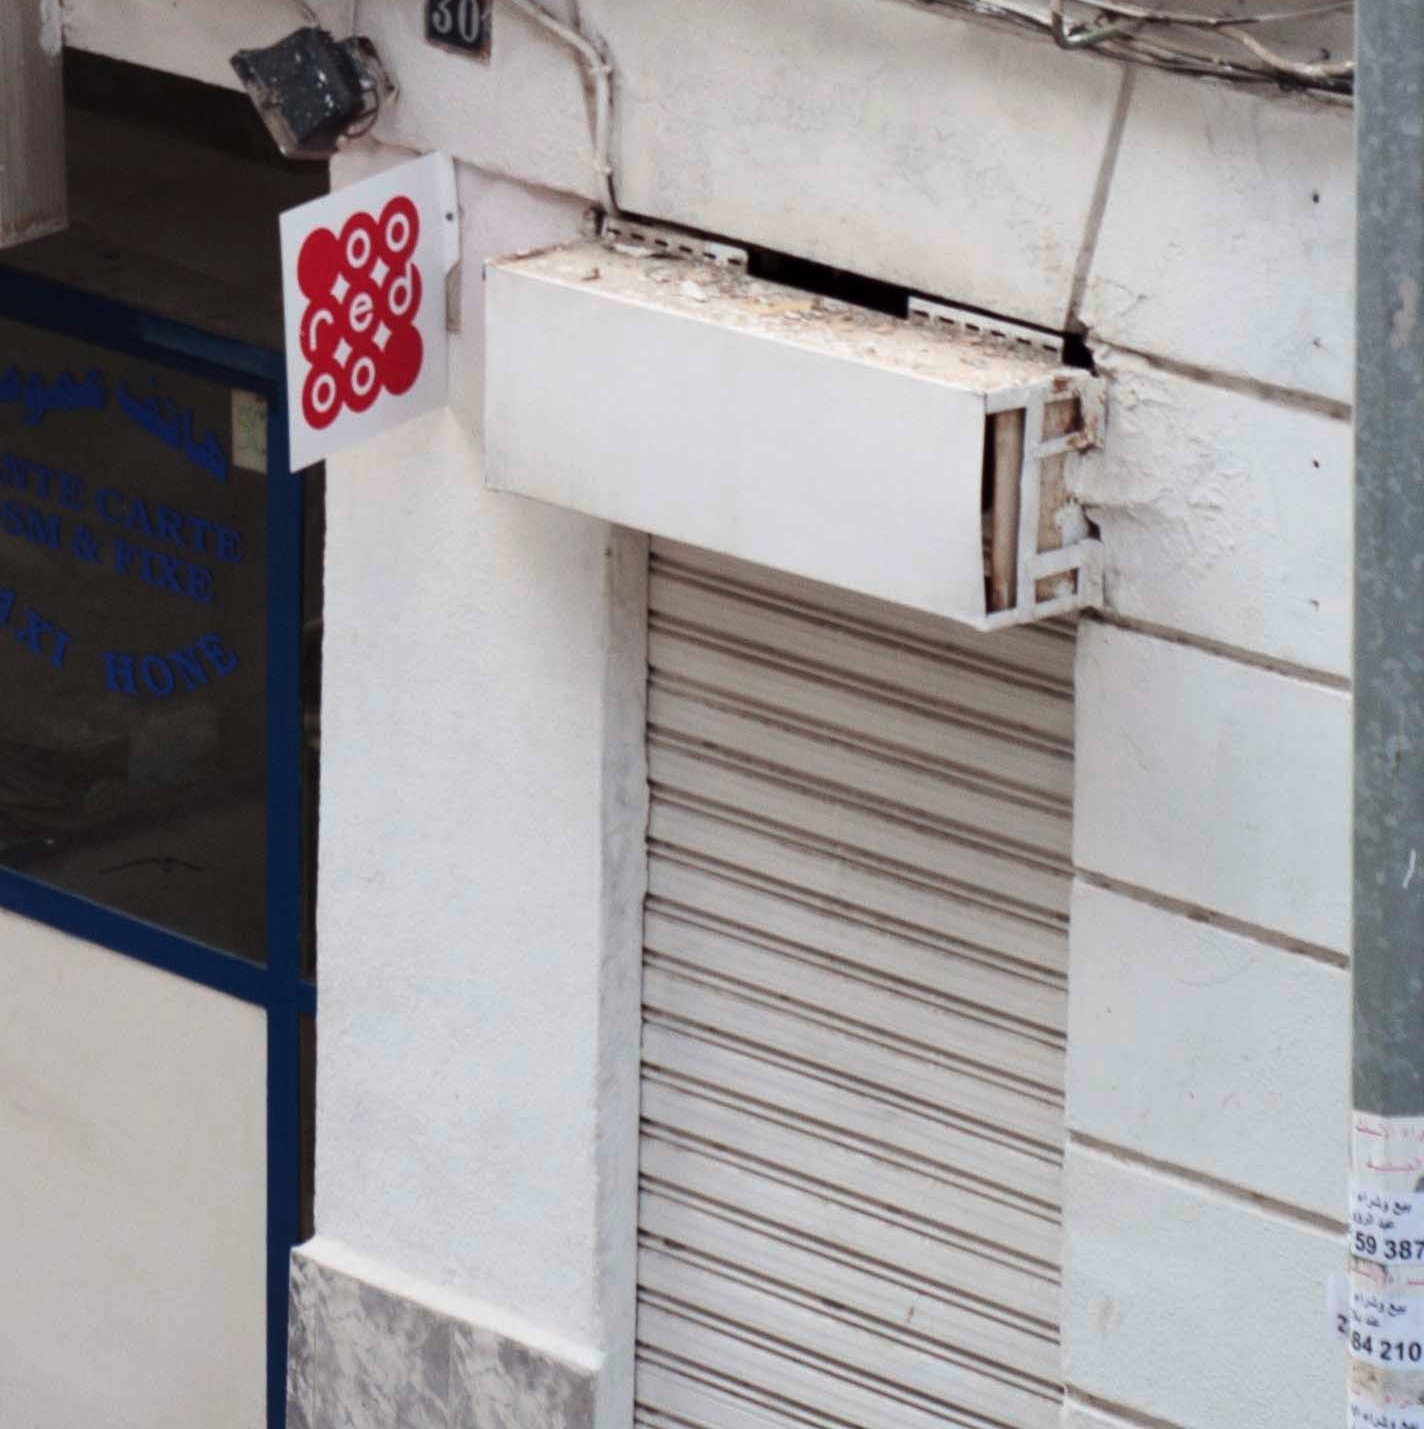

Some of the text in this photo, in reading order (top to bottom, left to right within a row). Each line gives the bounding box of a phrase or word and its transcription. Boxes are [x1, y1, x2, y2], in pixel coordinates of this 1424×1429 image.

[115, 372, 232, 484] هاتف
[70, 523, 103, 567] &
[112, 537, 218, 605] FIXE
[94, 485, 245, 566] CARTE
[1355, 1231, 1377, 1256] 59
[1352, 1331, 1423, 1362] 84 210
